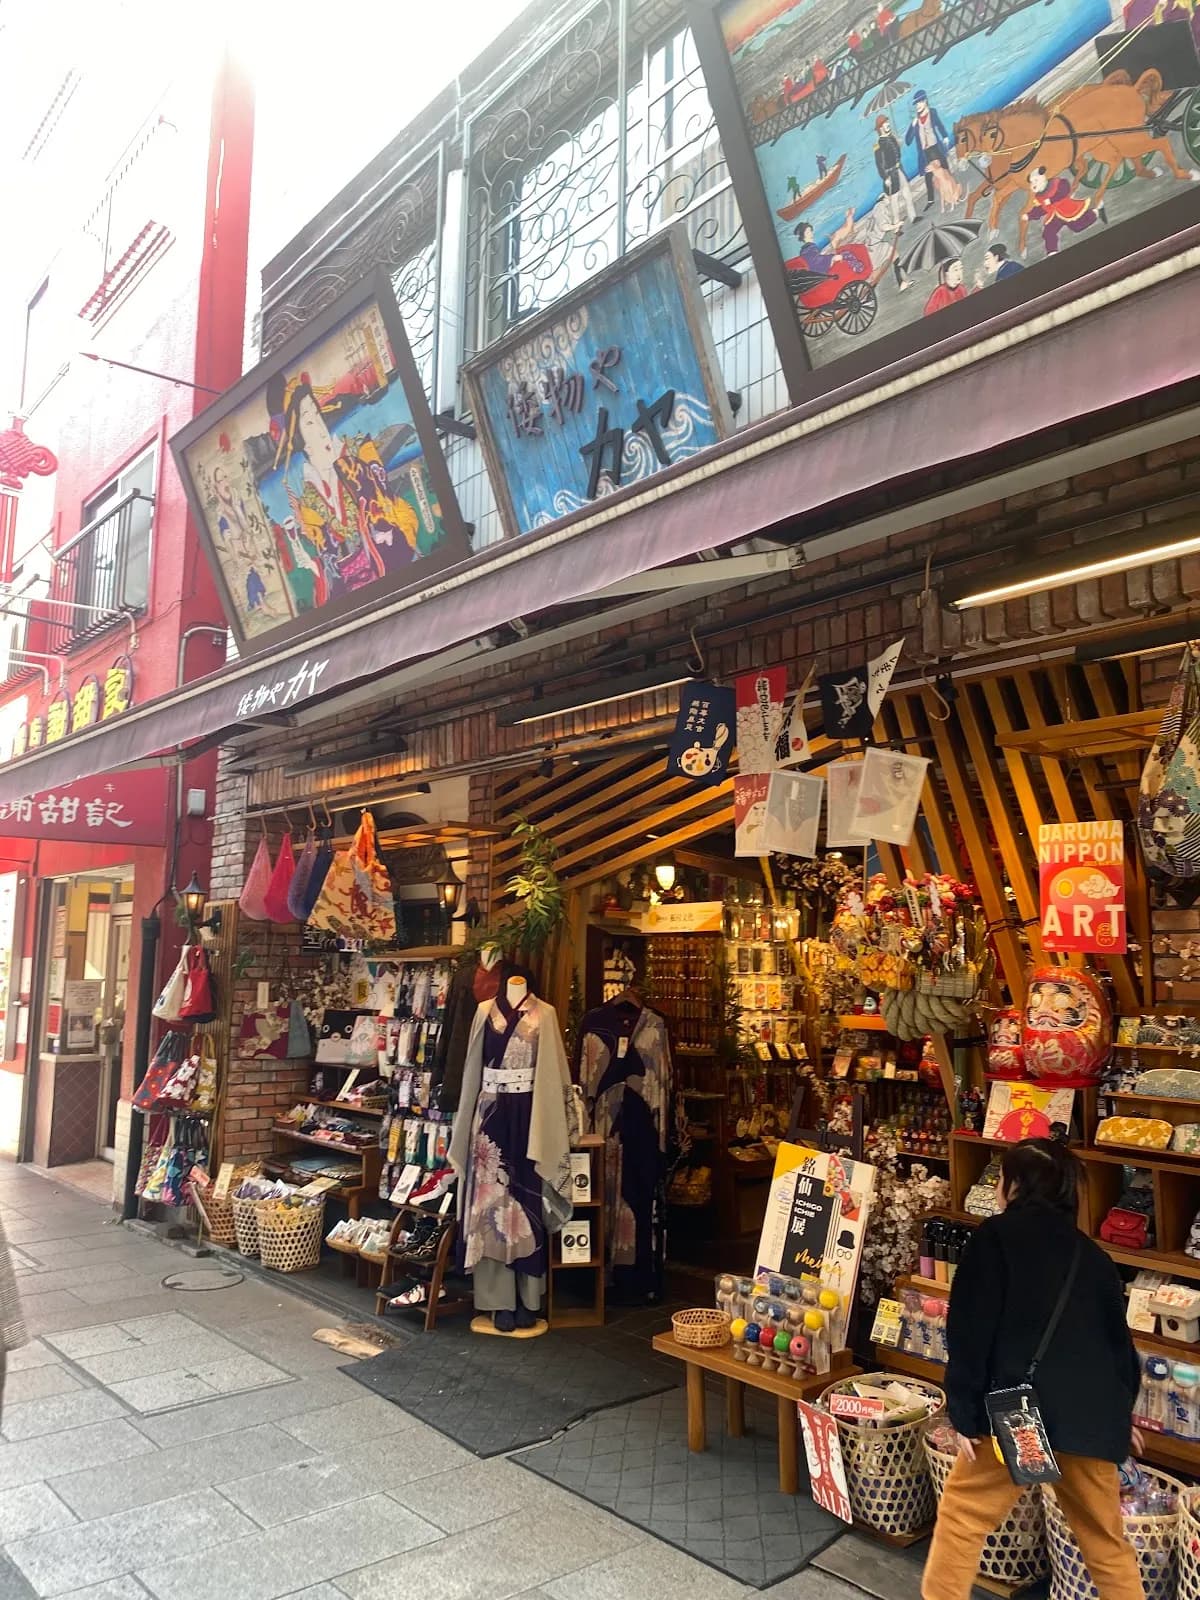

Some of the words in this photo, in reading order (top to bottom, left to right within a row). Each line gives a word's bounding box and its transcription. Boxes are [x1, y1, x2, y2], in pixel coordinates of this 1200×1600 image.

[579, 389, 676, 498] カヤ
[1039, 821, 1123, 842] DARUMA
[1039, 841, 1124, 864] NIPPON
[1042, 904, 1125, 938] ART
[795, 1199, 823, 1212] ICHIGO
[791, 1215, 807, 1236] 展
[811, 1479, 853, 1524] SALE
